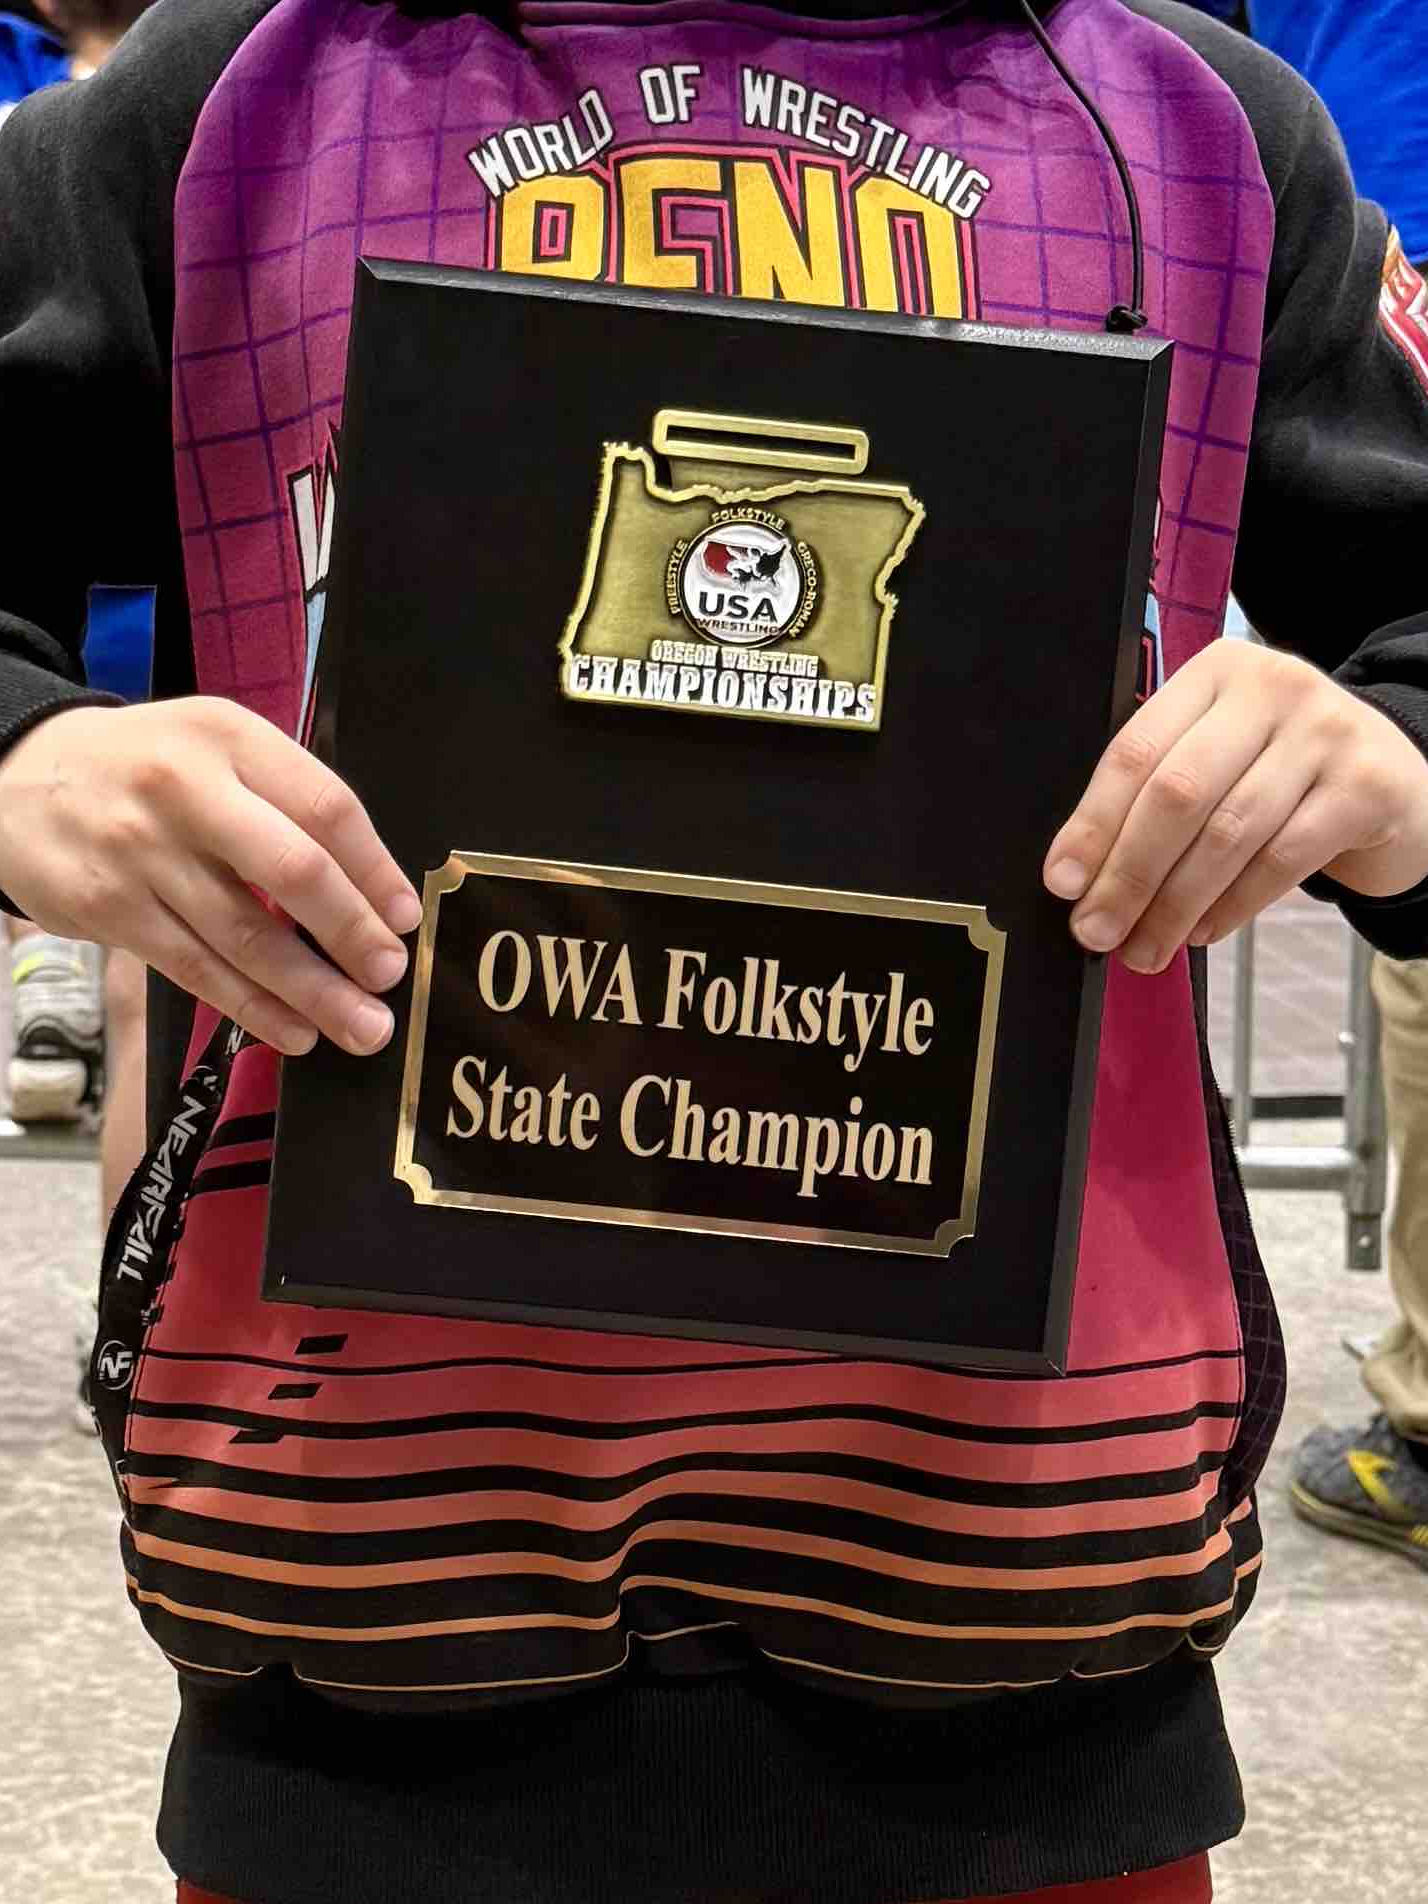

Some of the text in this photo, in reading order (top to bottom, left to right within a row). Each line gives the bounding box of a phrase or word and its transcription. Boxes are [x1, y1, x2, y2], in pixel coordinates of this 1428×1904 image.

[468, 64, 990, 219] WORLD OF WRESTLING
[711, 507, 785, 530] FOLKSTYLE
[696, 617, 780, 636] WRESTLING
[698, 591, 778, 623] USA
[789, 541, 817, 638] GRECO-ROMAN
[571, 654, 877, 723] CHAMPIONSHIPS
[650, 639, 819, 677] OREGON WRESTLING
[478, 929, 935, 1072] OWA Folkstyle
[446, 1054, 935, 1199] State Champion
[116, 1095, 206, 1282] NEARFALL
